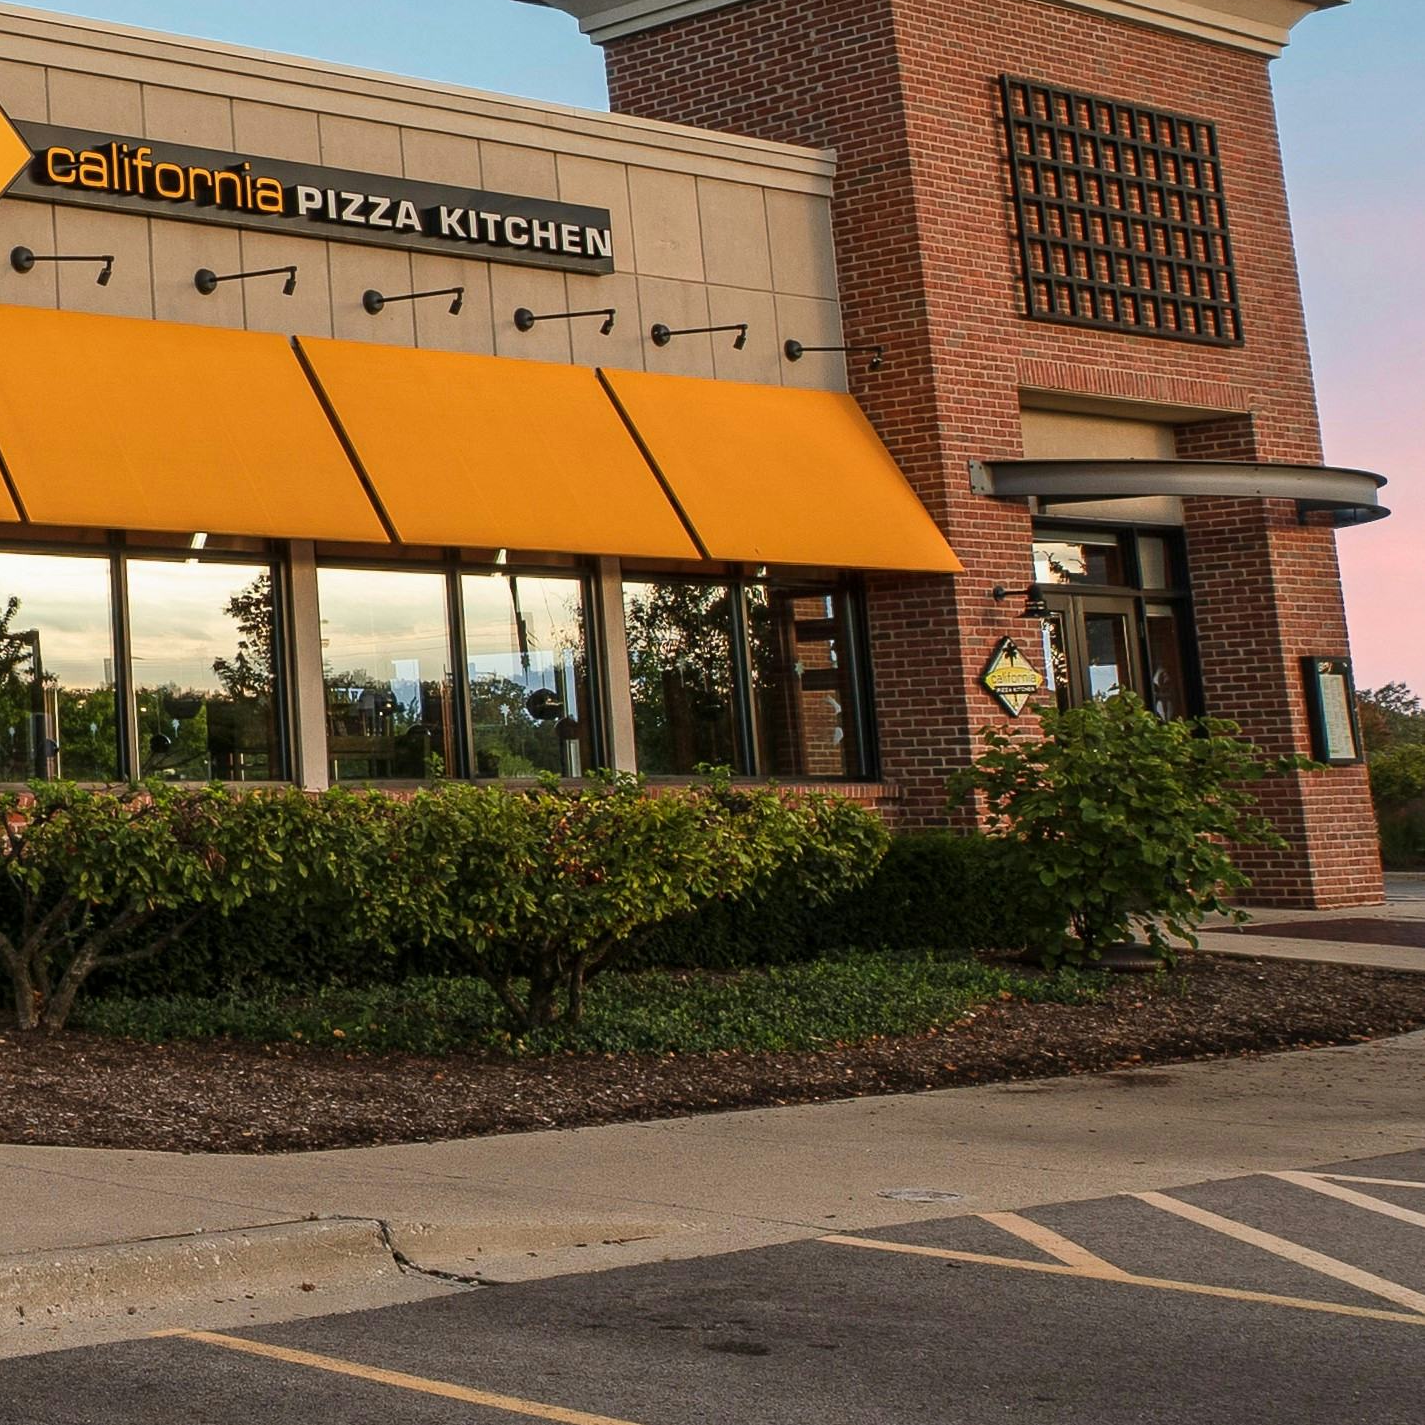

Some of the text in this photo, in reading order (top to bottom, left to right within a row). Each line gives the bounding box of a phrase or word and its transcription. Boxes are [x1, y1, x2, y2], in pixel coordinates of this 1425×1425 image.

[47, 141, 614, 258] california PIZZA KITCHEN
